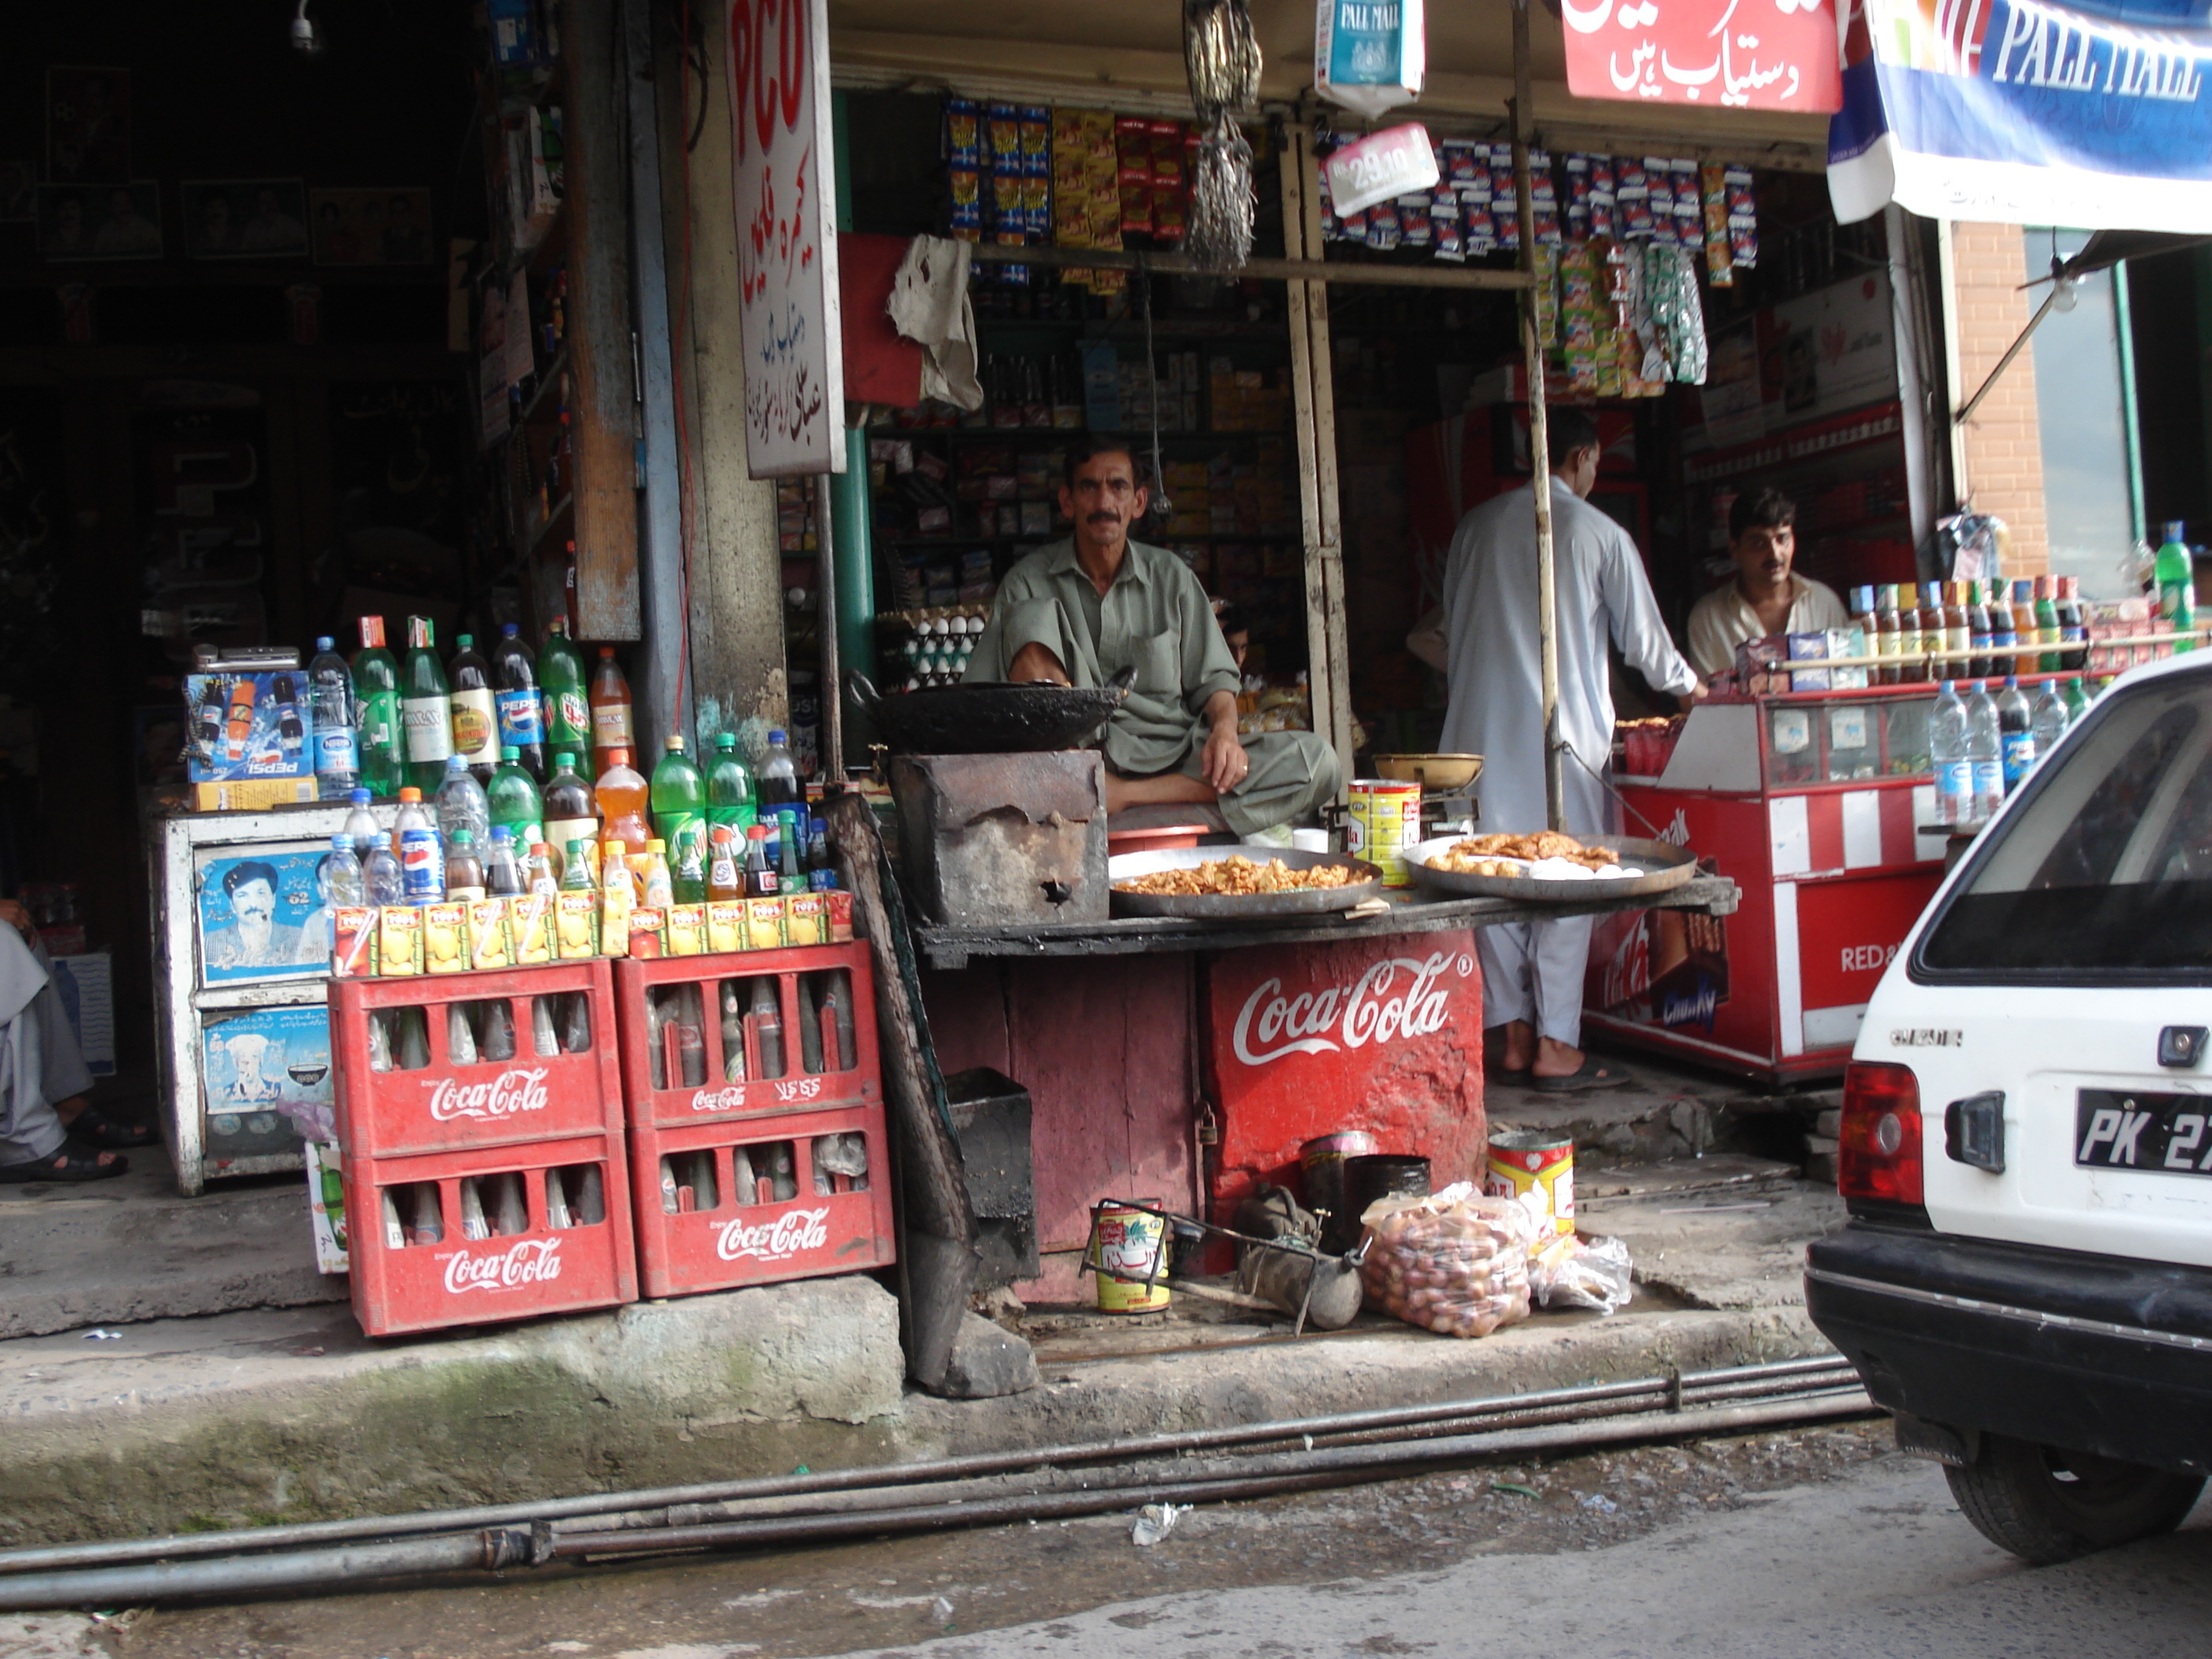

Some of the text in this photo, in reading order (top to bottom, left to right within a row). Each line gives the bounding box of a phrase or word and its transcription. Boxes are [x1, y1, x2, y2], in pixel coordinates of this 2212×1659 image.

[1341, 3, 1400, 30] PALL MALL
[732, 0, 803, 163] PCO
[1610, 38, 1664, 97] ہیں
[1661, 27, 1801, 107] دستیاب
[1992, 4, 2098, 91] PALL
[2103, 33, 2202, 102] MALL
[1349, 147, 1409, 192] 29.10
[500, 698, 540, 711] PEPSI
[248, 762, 298, 775] PEPSI
[1232, 950, 1456, 1067] Coca-Cola
[430, 1067, 549, 1121] Coca-Cola
[691, 1086, 746, 1111] Coca-Cola
[2078, 1108, 2152, 1166] PK
[717, 1206, 830, 1262] Coca-Cola
[444, 1236, 562, 1295] Coca-Cola
